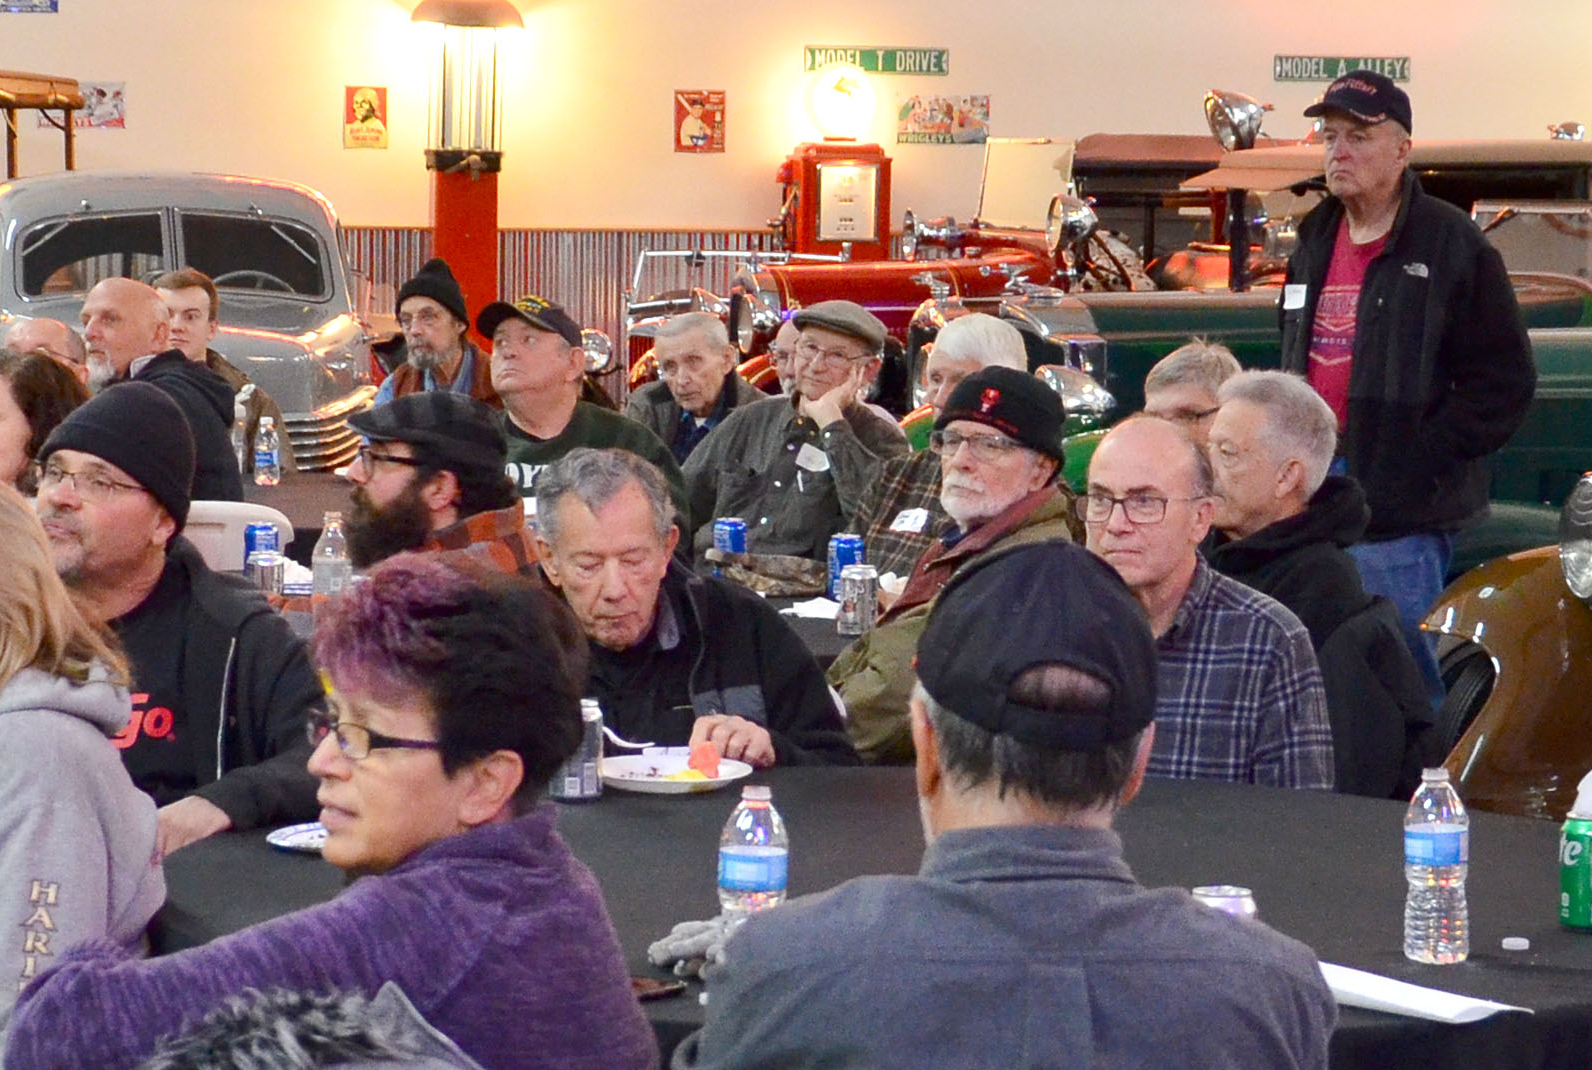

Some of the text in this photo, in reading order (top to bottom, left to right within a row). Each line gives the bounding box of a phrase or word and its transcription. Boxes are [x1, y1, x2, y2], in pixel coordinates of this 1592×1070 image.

[815, 49, 940, 72] MODEL T DRIVE
[1281, 58, 1405, 79] MODEL A ALLEY
